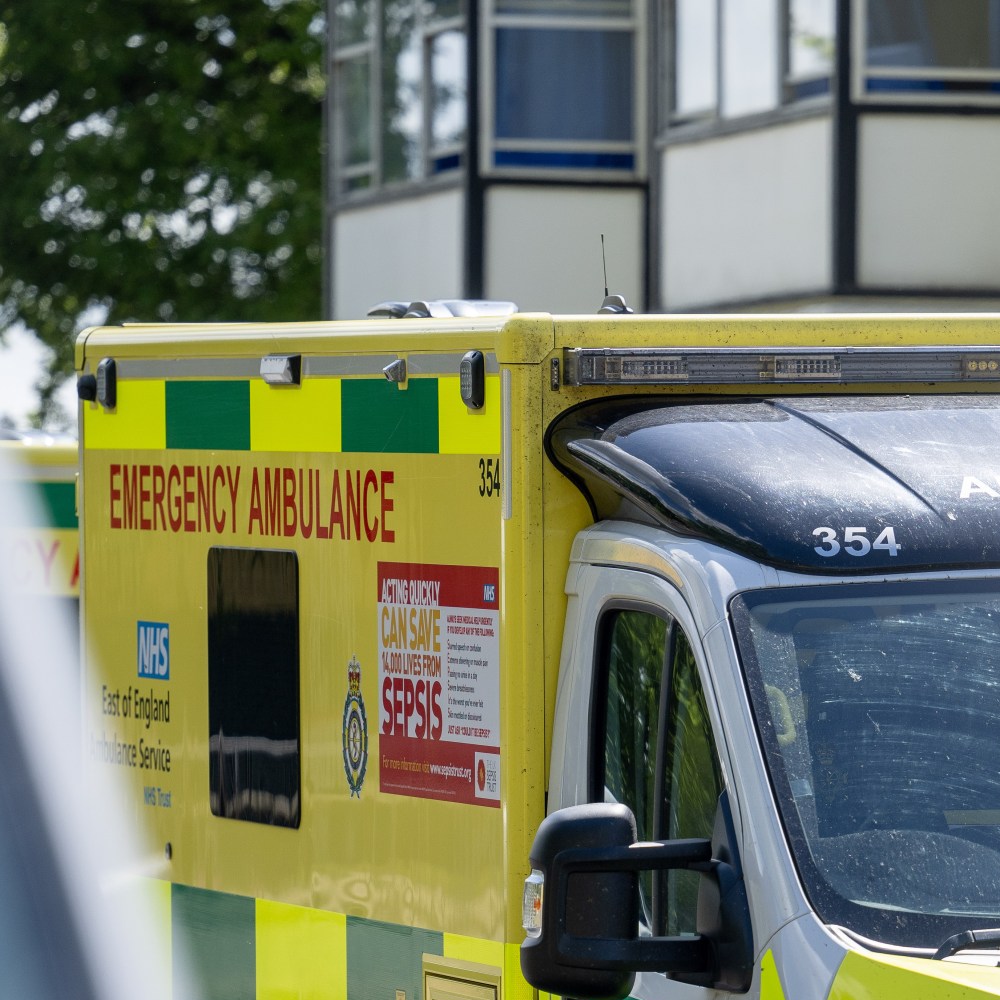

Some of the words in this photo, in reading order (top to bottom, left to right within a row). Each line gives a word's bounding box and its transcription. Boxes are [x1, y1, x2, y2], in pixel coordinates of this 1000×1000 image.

[478, 457, 500, 498] 354
[109, 464, 241, 534] EMERGENCY
[248, 467, 396, 543] AMBULANCE
[811, 525, 902, 557] 354
[382, 578, 408, 604] ACTING
[409, 579, 440, 606] QUICKLY
[483, 584, 495, 601] NHS
[381, 605, 407, 649] CAN
[409, 607, 441, 652] SAVE
[138, 626, 169, 677] NHS
[382, 651, 401, 676] 14,000
[403, 652, 421, 677] LIVES
[422, 654, 441, 678] FROM
[102, 685, 120, 717] East
[122, 686, 132, 719] of
[134, 688, 170, 729] England
[382, 676, 443, 740] SEPSIS
[139, 738, 171, 773] Service
[389, 759, 400, 770] more
[400, 757, 421, 773] information
[422, 761, 430, 773] visit
[430, 763, 472, 783] www.sepsistrust.org
[143, 786, 156, 807] NHS
[157, 788, 172, 808] Trust
